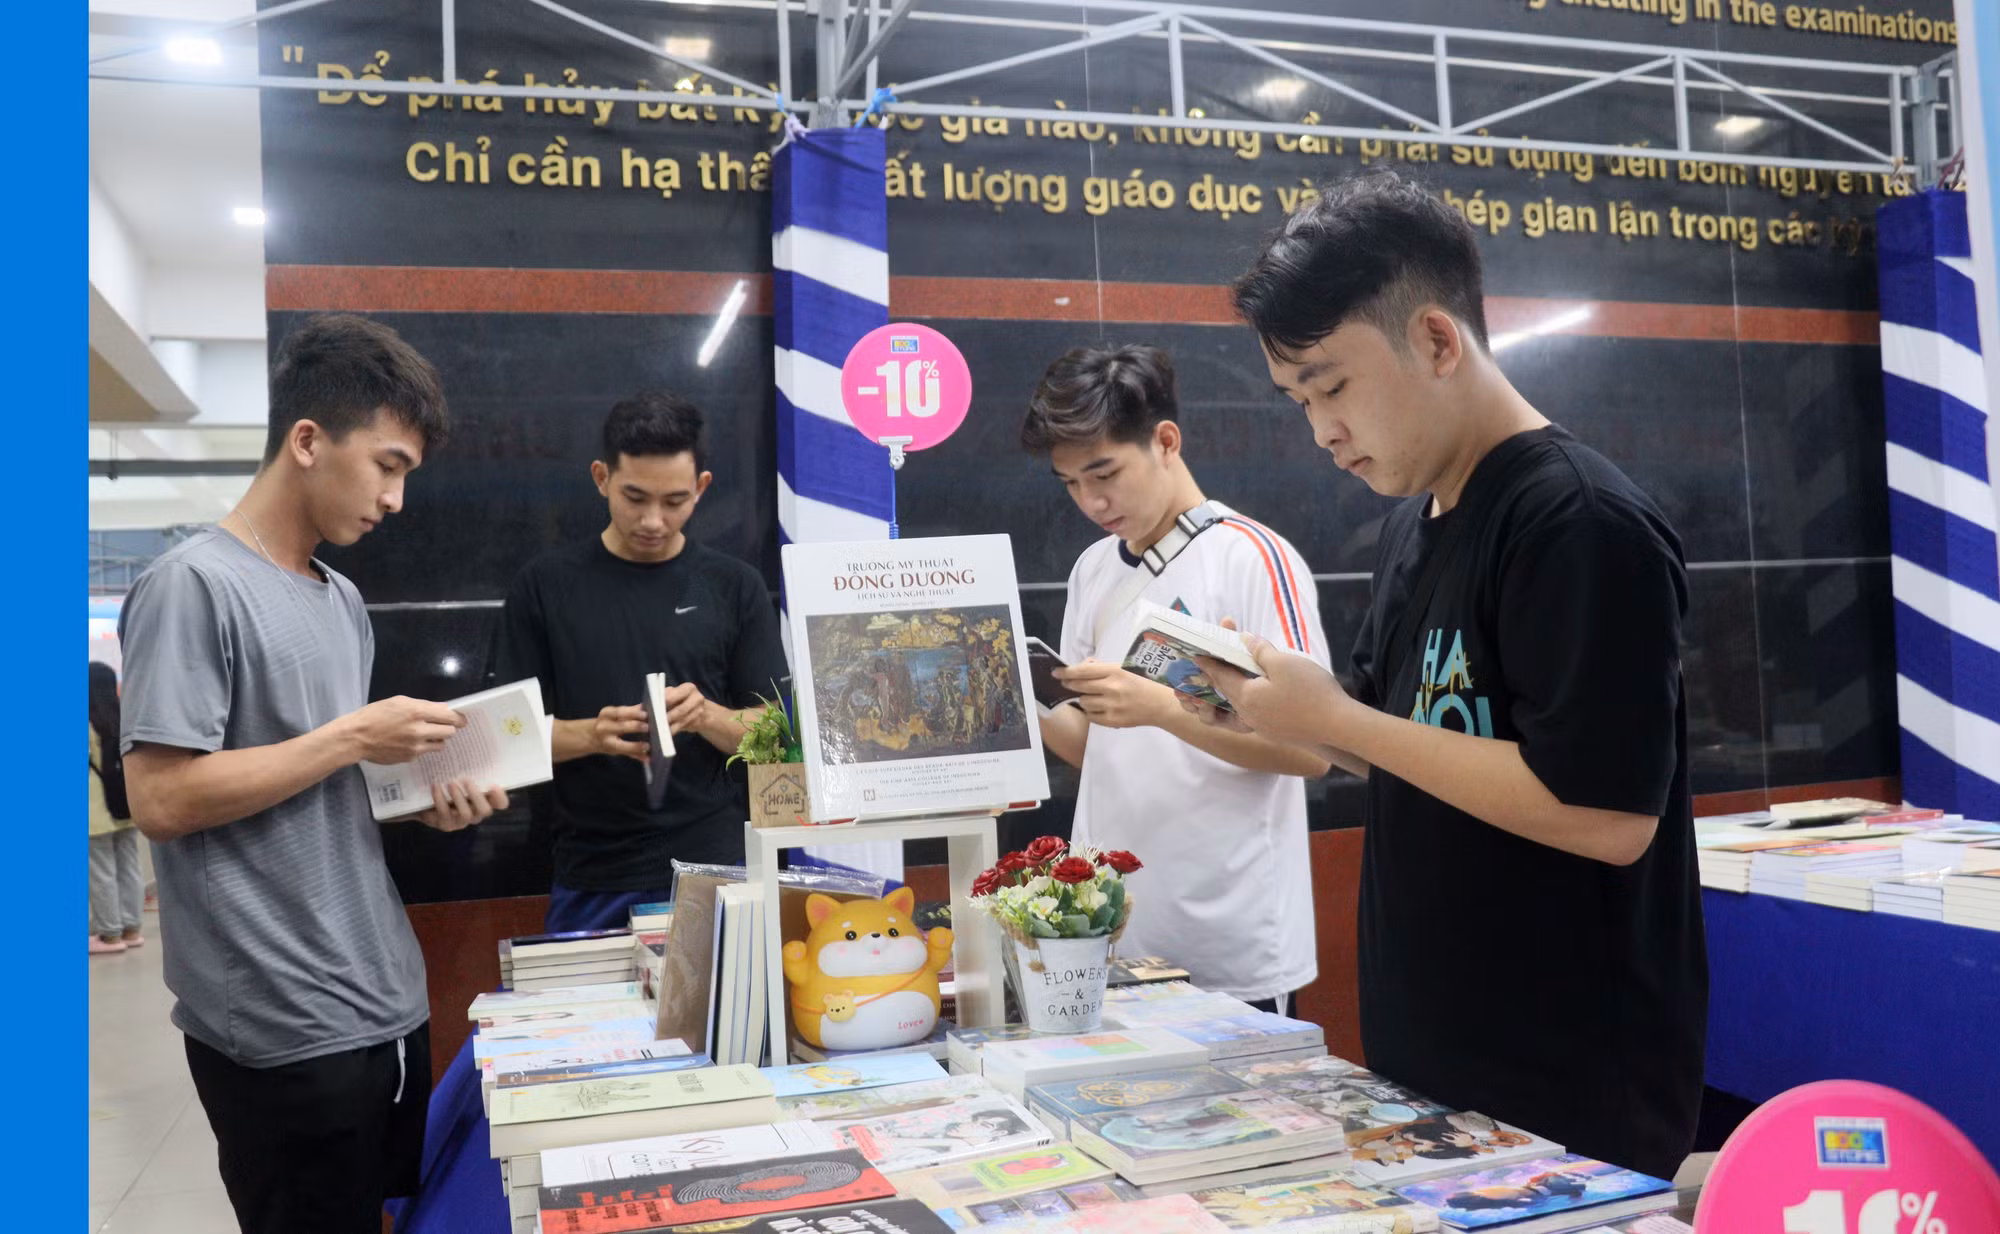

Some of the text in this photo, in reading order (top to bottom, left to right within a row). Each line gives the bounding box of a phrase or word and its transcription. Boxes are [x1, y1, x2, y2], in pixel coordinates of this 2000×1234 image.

[1729, 0, 1776, 25] the
[1786, 4, 1958, 44] examinations
[406, 136, 491, 184] Chỉ
[507, 135, 601, 188] cần
[621, 147, 681, 199] hạ
[943, 162, 1068, 213] lượng
[1083, 168, 1175, 215] giáo
[1189, 173, 1262, 220] dục
[1443, 189, 1511, 235] hép
[1523, 196, 1597, 238] gian
[1609, 201, 1659, 243] lận
[1669, 206, 1758, 250] trong
[833, 568, 975, 591] ĐÔNG DƯƠNG
[1147, 645, 1174, 676] SLIME
[1422, 628, 1474, 689] HA
[1044, 967, 1107, 985] FLOWERS
